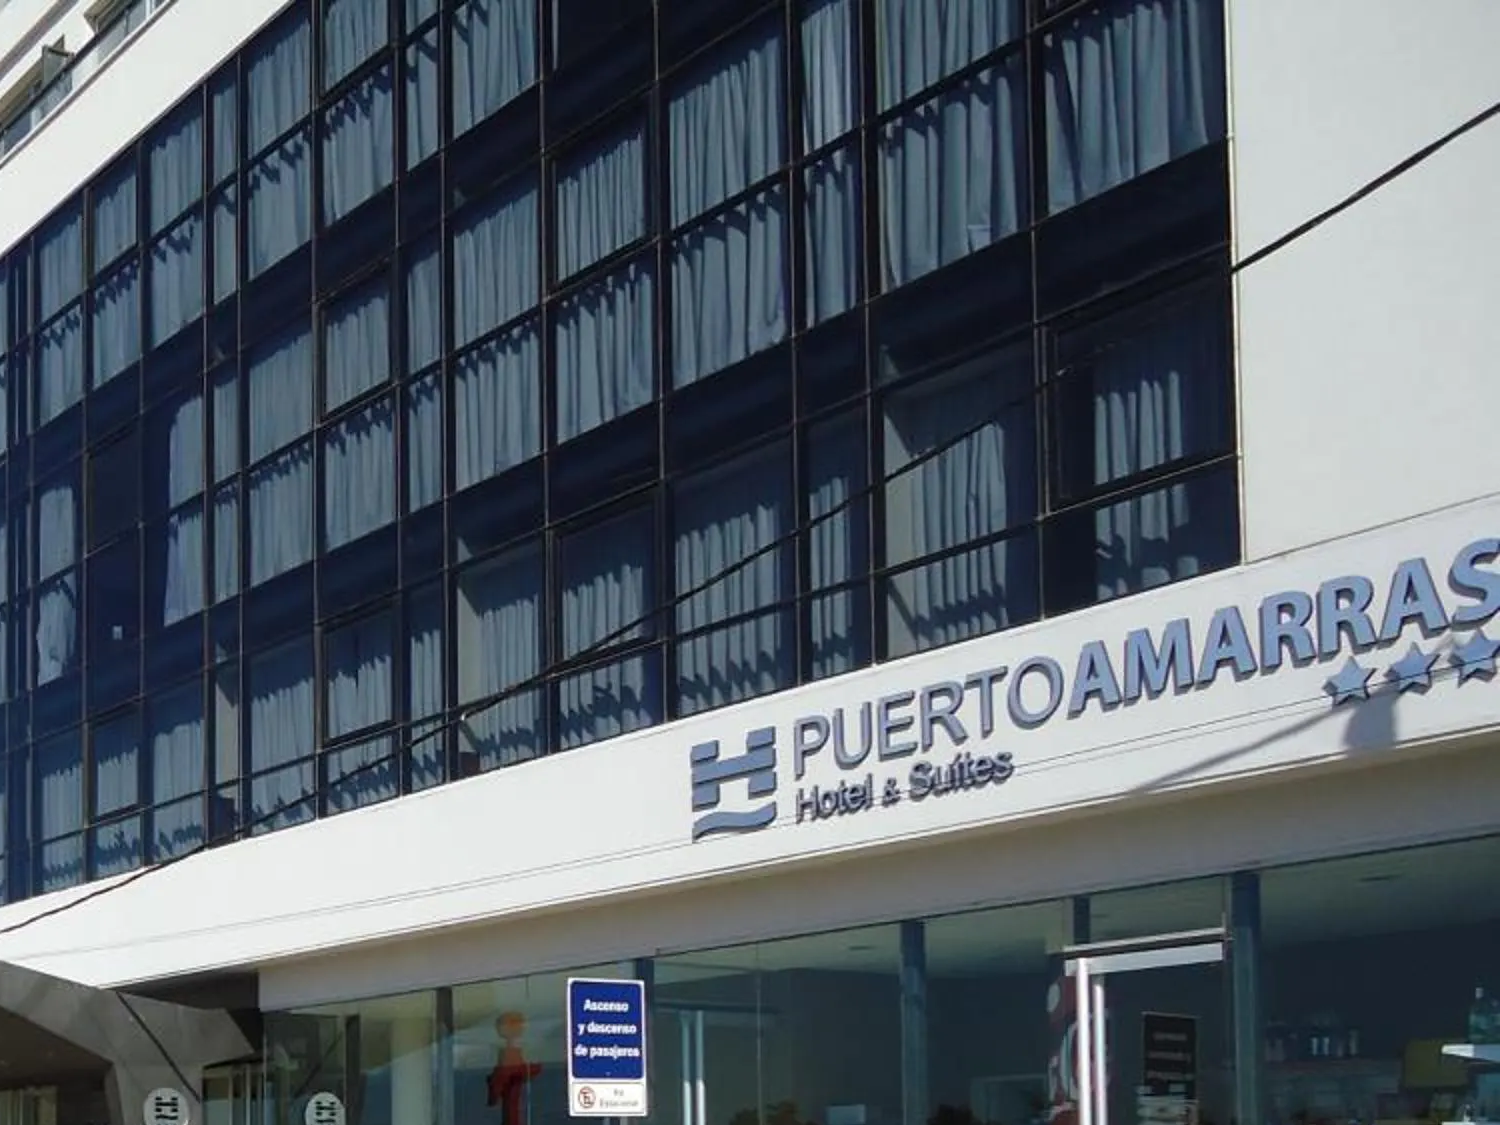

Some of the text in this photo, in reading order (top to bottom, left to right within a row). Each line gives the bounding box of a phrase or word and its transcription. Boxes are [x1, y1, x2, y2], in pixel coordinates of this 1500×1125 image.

[795, 773, 874, 824] Hotel
[881, 777, 901, 807] &
[583, 999, 629, 1012] Ascenso
[577, 1021, 637, 1036] y descenso
[574, 1044, 588, 1057] de
